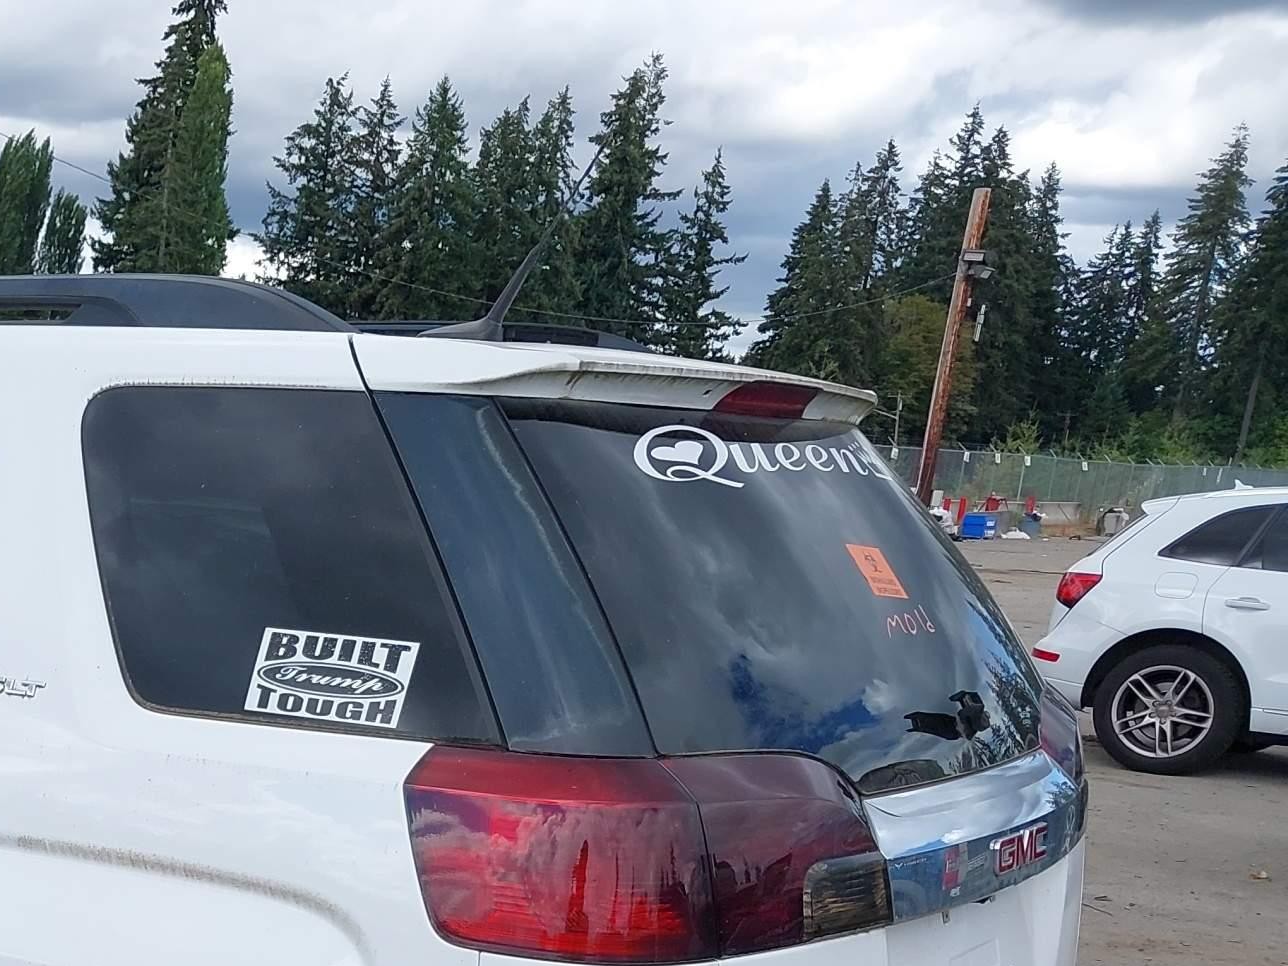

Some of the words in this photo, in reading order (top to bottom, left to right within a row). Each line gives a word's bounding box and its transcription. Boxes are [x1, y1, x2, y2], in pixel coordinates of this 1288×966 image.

[633, 425, 868, 488] Queen
[264, 632, 412, 674] BUILT
[275, 666, 385, 694] Trump
[256, 683, 398, 725] TOUGH
[993, 821, 1048, 876] GMC
